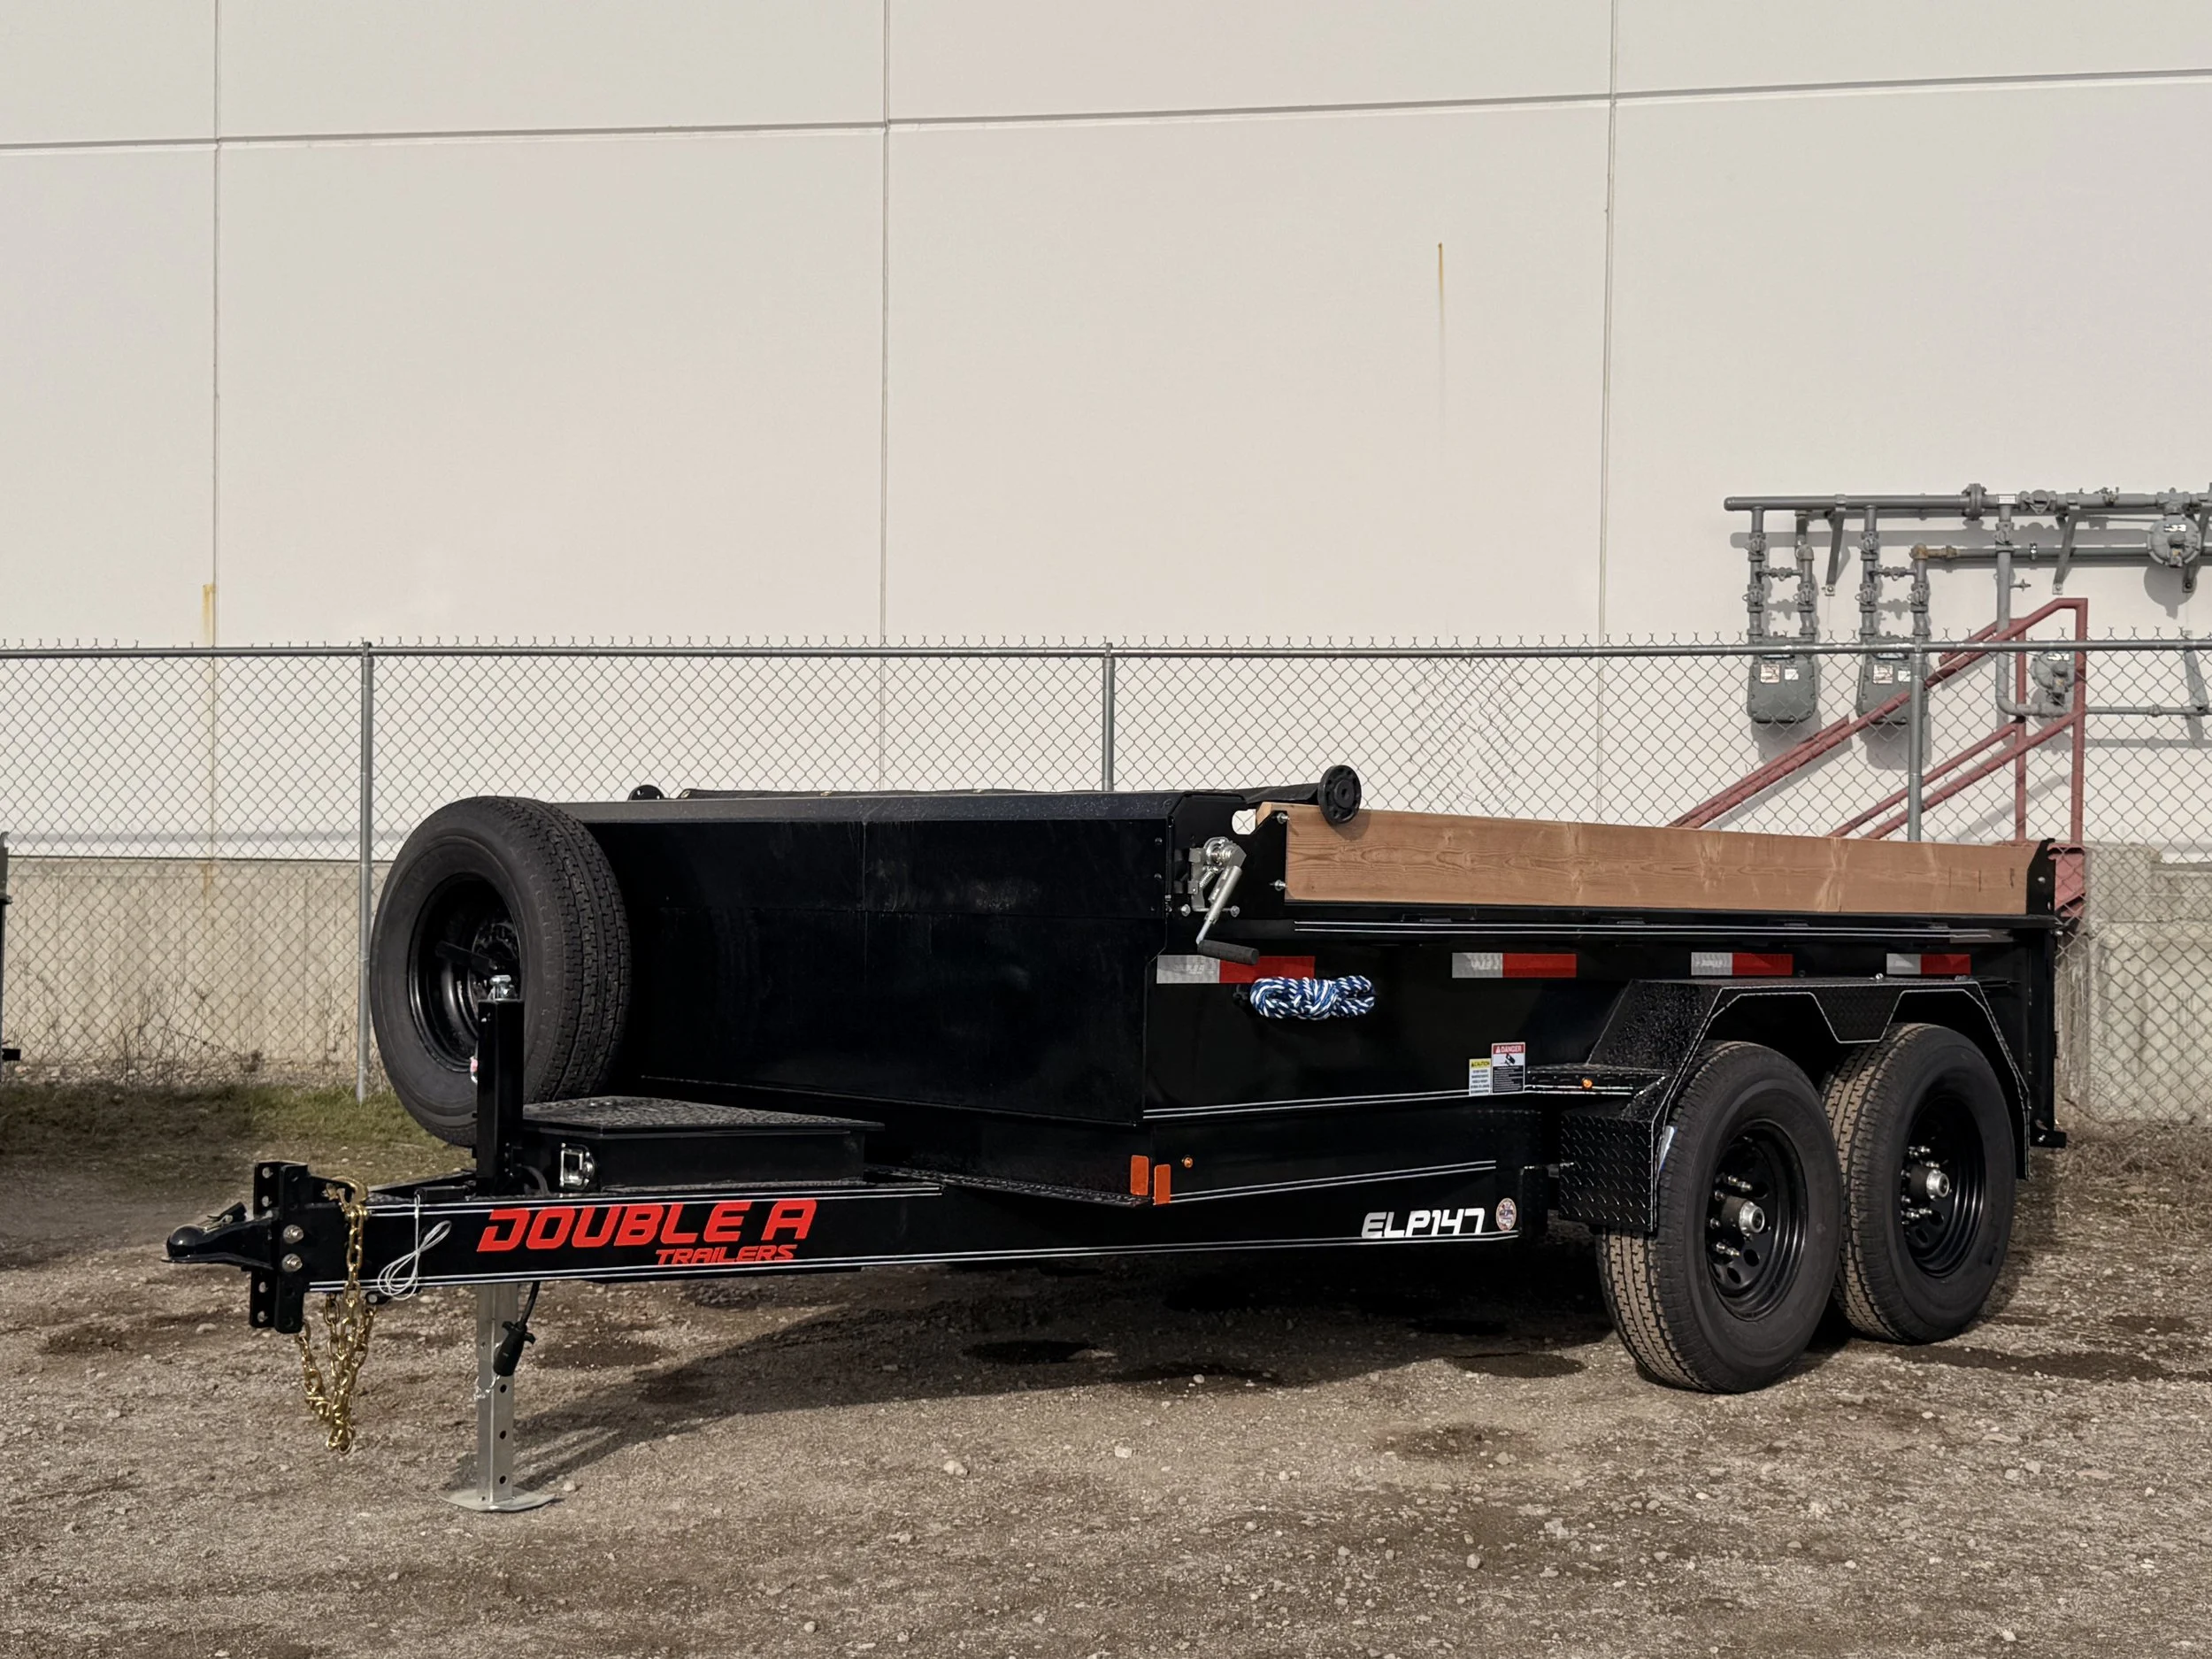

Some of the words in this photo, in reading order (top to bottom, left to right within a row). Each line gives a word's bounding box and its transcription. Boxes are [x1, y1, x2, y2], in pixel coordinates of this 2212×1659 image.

[478, 1202, 752, 1252] DOUBLE
[761, 1199, 818, 1240] A
[1361, 1207, 1486, 1239] ELP147
[656, 1244, 797, 1265] TRAILERS
